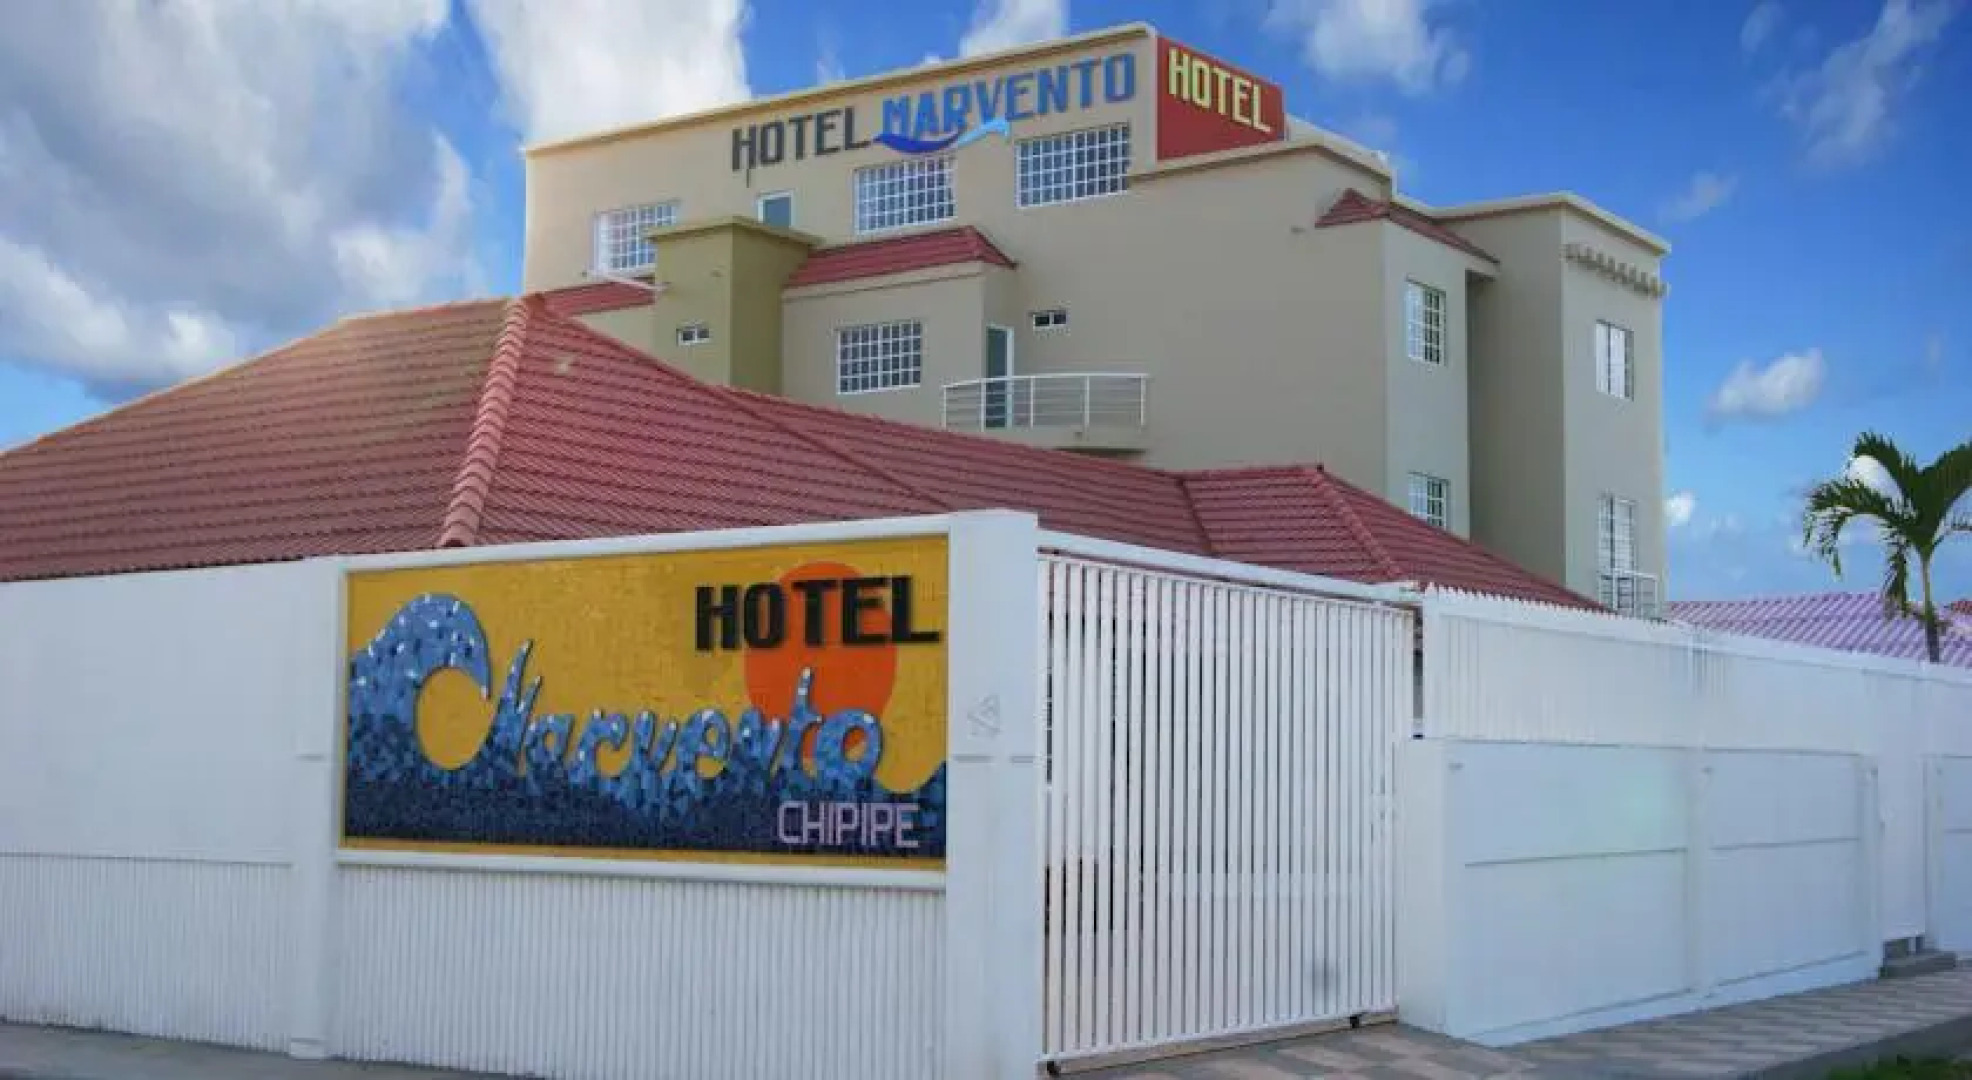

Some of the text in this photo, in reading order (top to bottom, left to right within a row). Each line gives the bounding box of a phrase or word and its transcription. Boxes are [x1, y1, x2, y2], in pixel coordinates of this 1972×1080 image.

[731, 52, 1136, 172] HOTEL MARVENTO
[1168, 48, 1271, 133] HOTEL
[694, 574, 942, 651] HOTEL
[398, 595, 884, 796] Marvento
[777, 800, 921, 849] CHIPIPE
